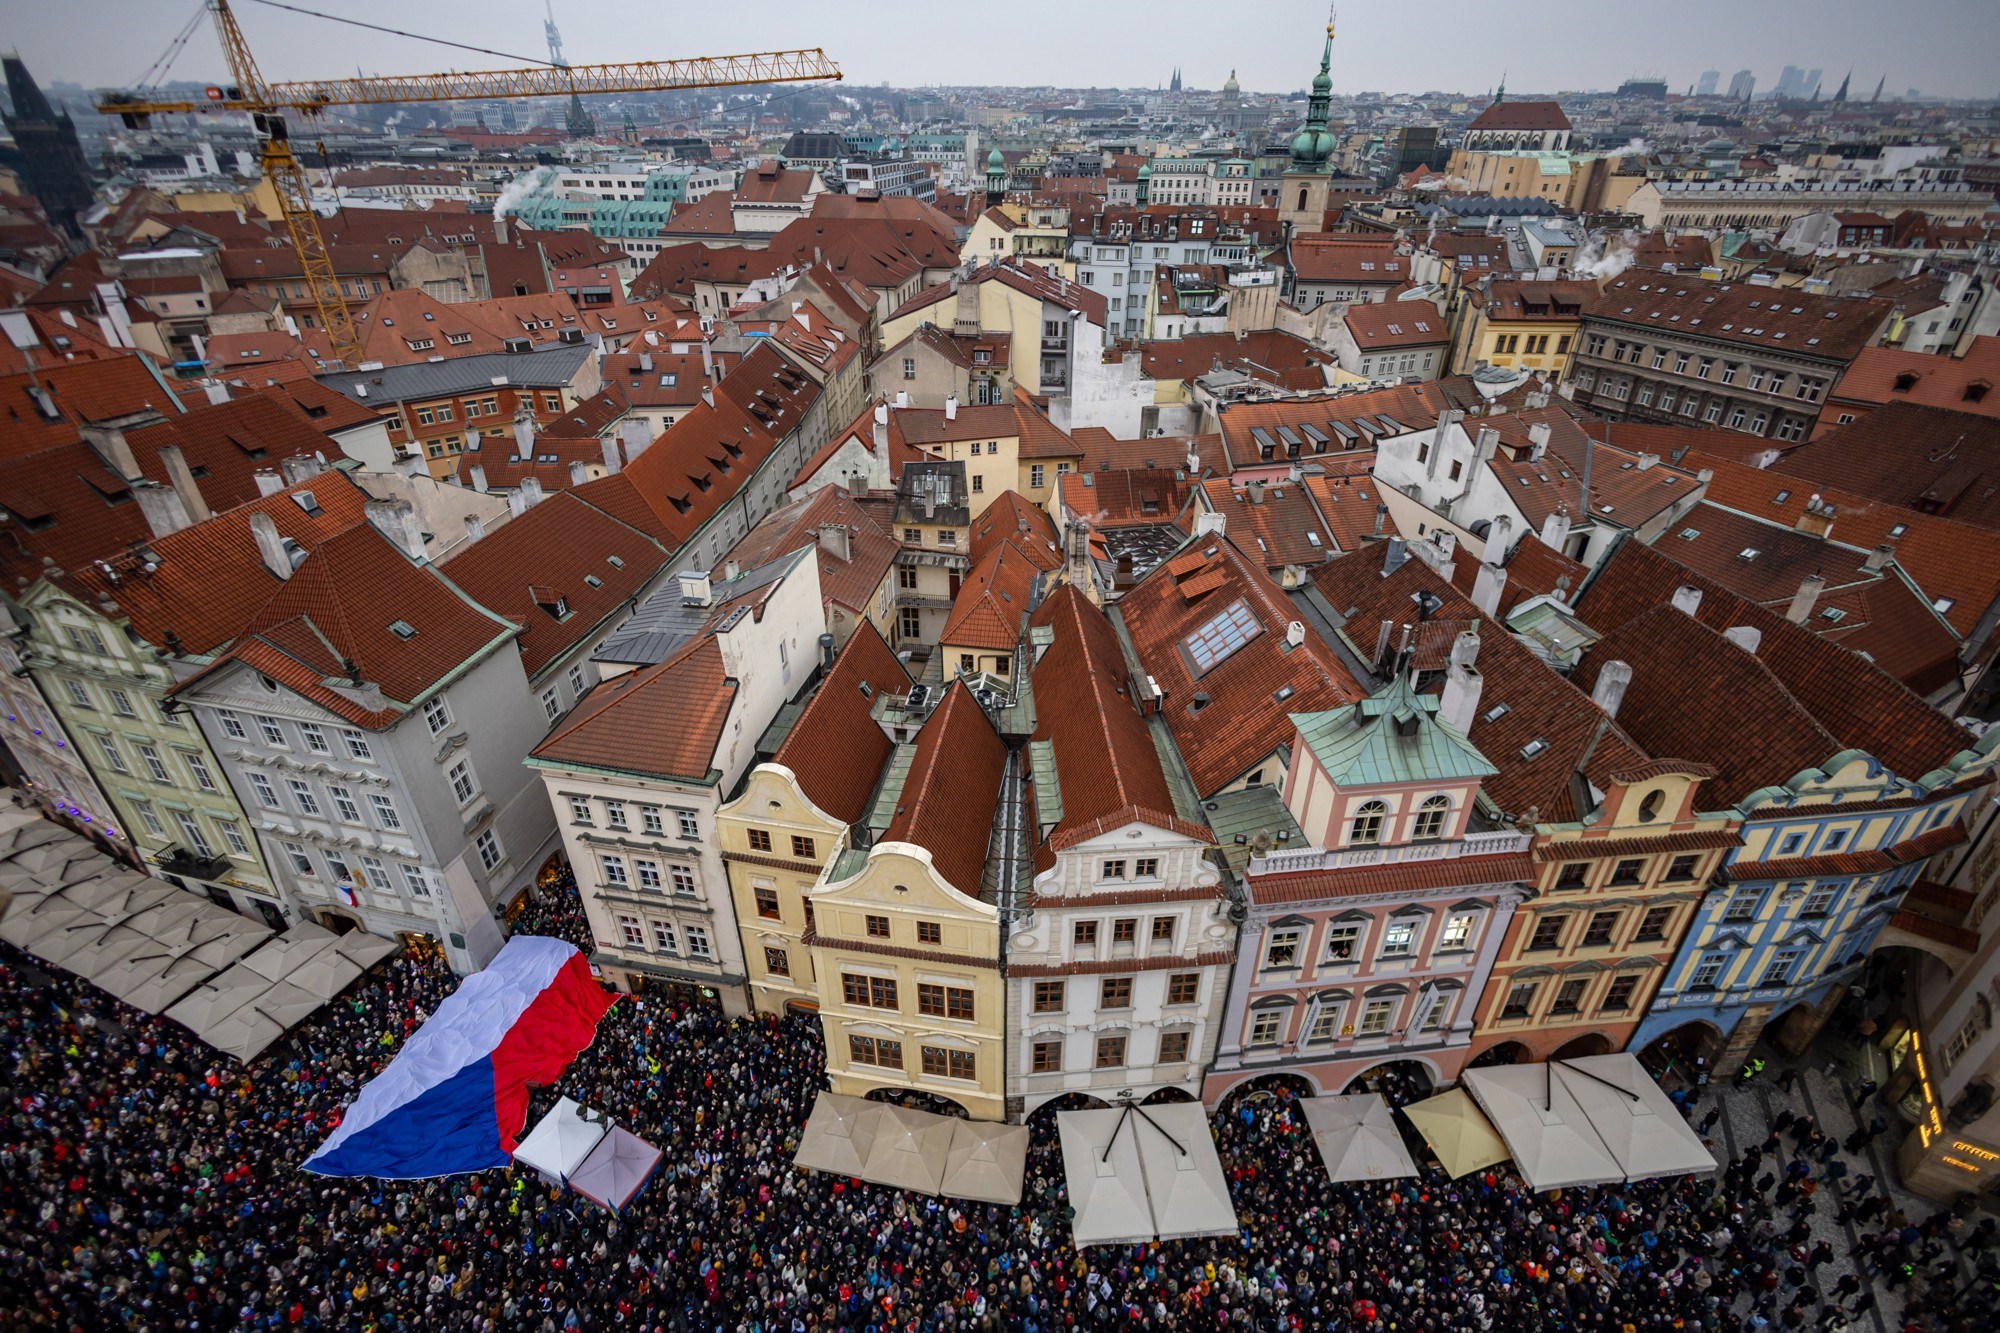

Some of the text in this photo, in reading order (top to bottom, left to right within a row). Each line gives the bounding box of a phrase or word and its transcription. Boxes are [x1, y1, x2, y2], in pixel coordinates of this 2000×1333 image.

[433, 878, 452, 925] HOTEL
[643, 971, 696, 982] STARBUCKS
[852, 1035, 899, 1049] CAFE
[924, 1047, 972, 1059] CAFE
[1953, 1141, 2000, 1161] ERPET
